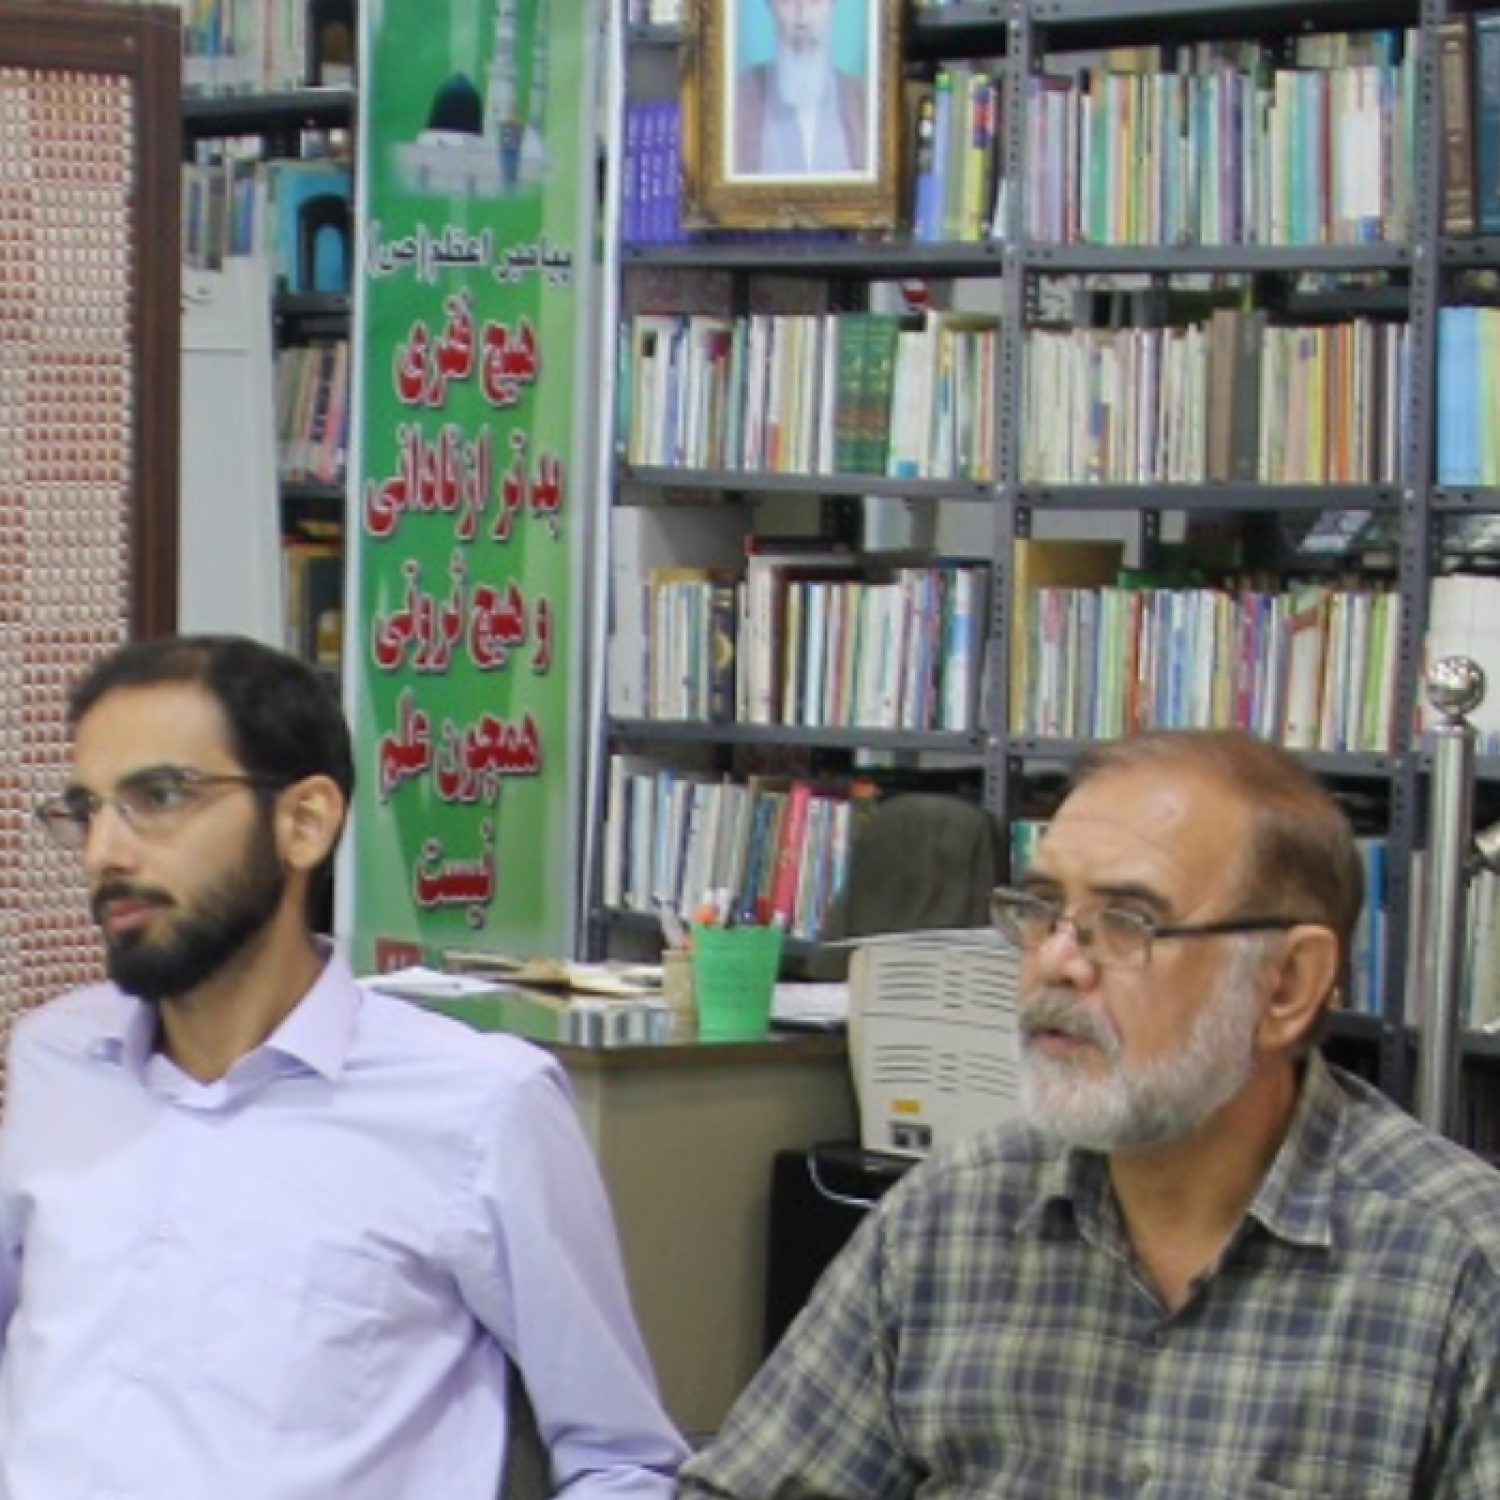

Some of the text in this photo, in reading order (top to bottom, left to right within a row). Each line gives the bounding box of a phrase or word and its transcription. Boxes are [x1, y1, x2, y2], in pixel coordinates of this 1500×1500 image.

[394, 287, 477, 408] فقری
[480, 319, 540, 406] هیچ
[378, 687, 541, 805] همچون علم
[414, 818, 495, 929] نیست
